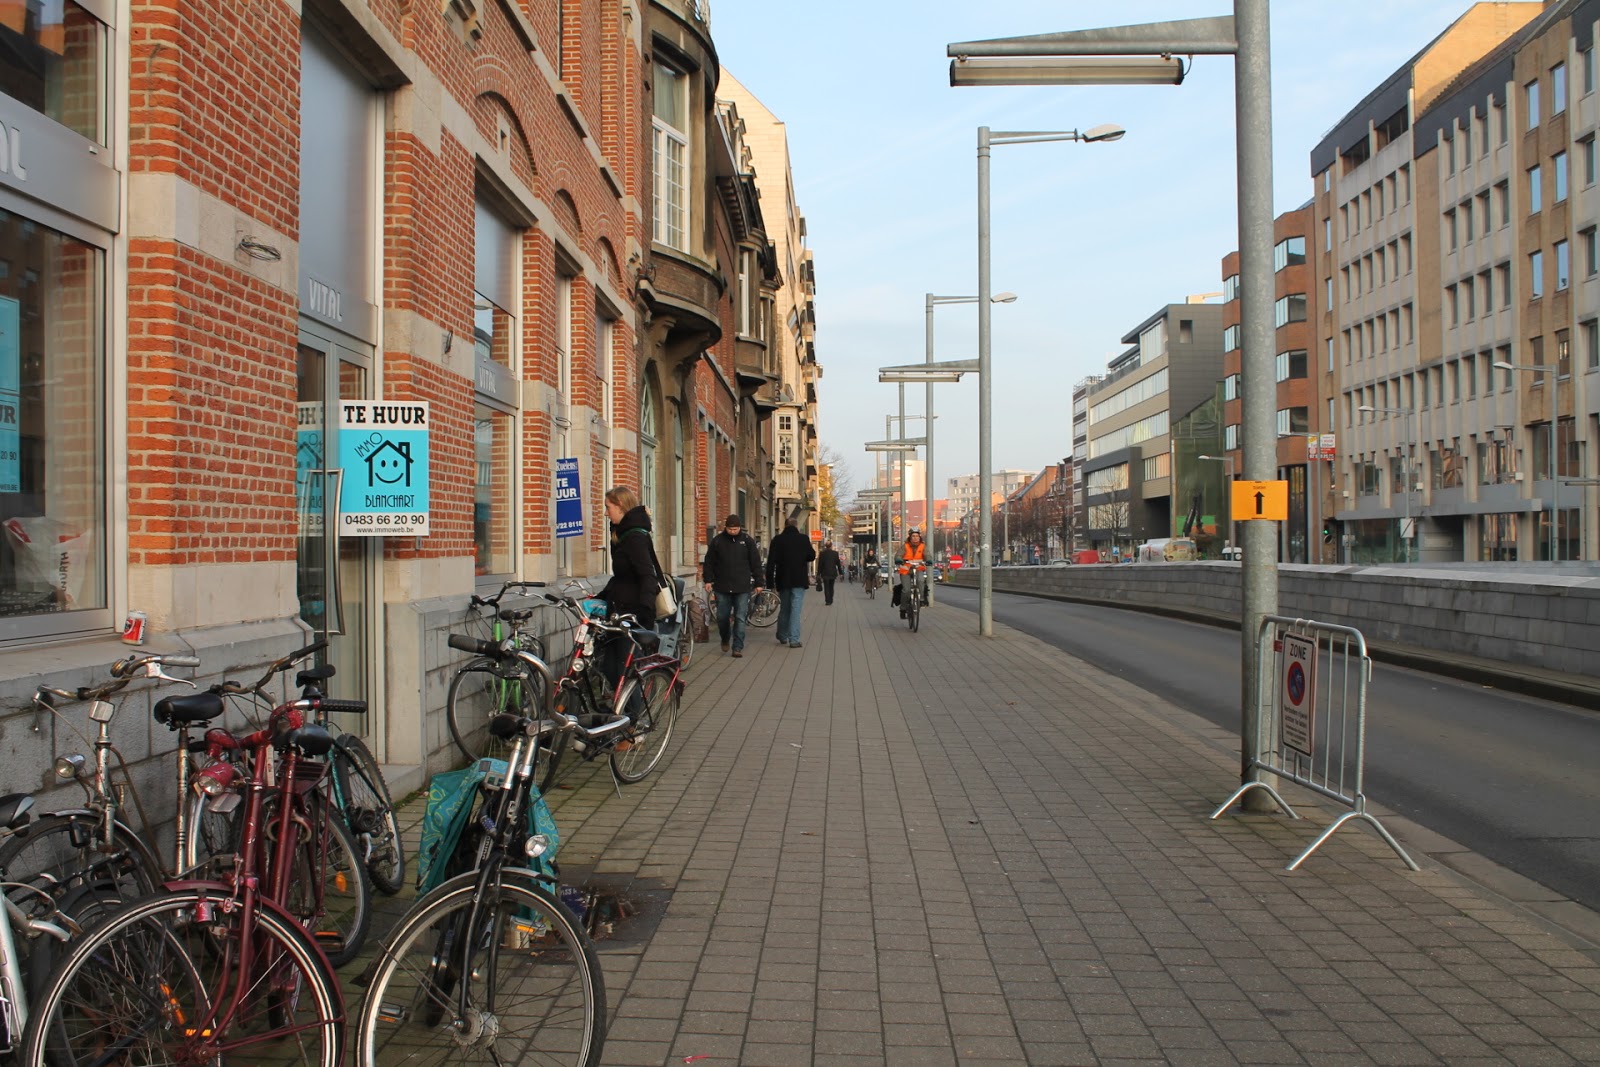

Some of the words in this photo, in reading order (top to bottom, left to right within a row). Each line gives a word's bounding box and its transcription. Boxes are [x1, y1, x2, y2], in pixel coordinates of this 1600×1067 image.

[309, 277, 342, 322] VITAL
[479, 366, 496, 393] VITAL
[344, 405, 366, 423] TE
[372, 406, 425, 424] HUUR
[354, 432, 383, 458] IMMO
[365, 494, 415, 508] BLANCHART
[345, 515, 373, 525] 0483
[376, 515, 391, 525] 66
[394, 515, 407, 525] 20
[411, 515, 425, 525] 90
[1289, 643, 1307, 660] ZONE
